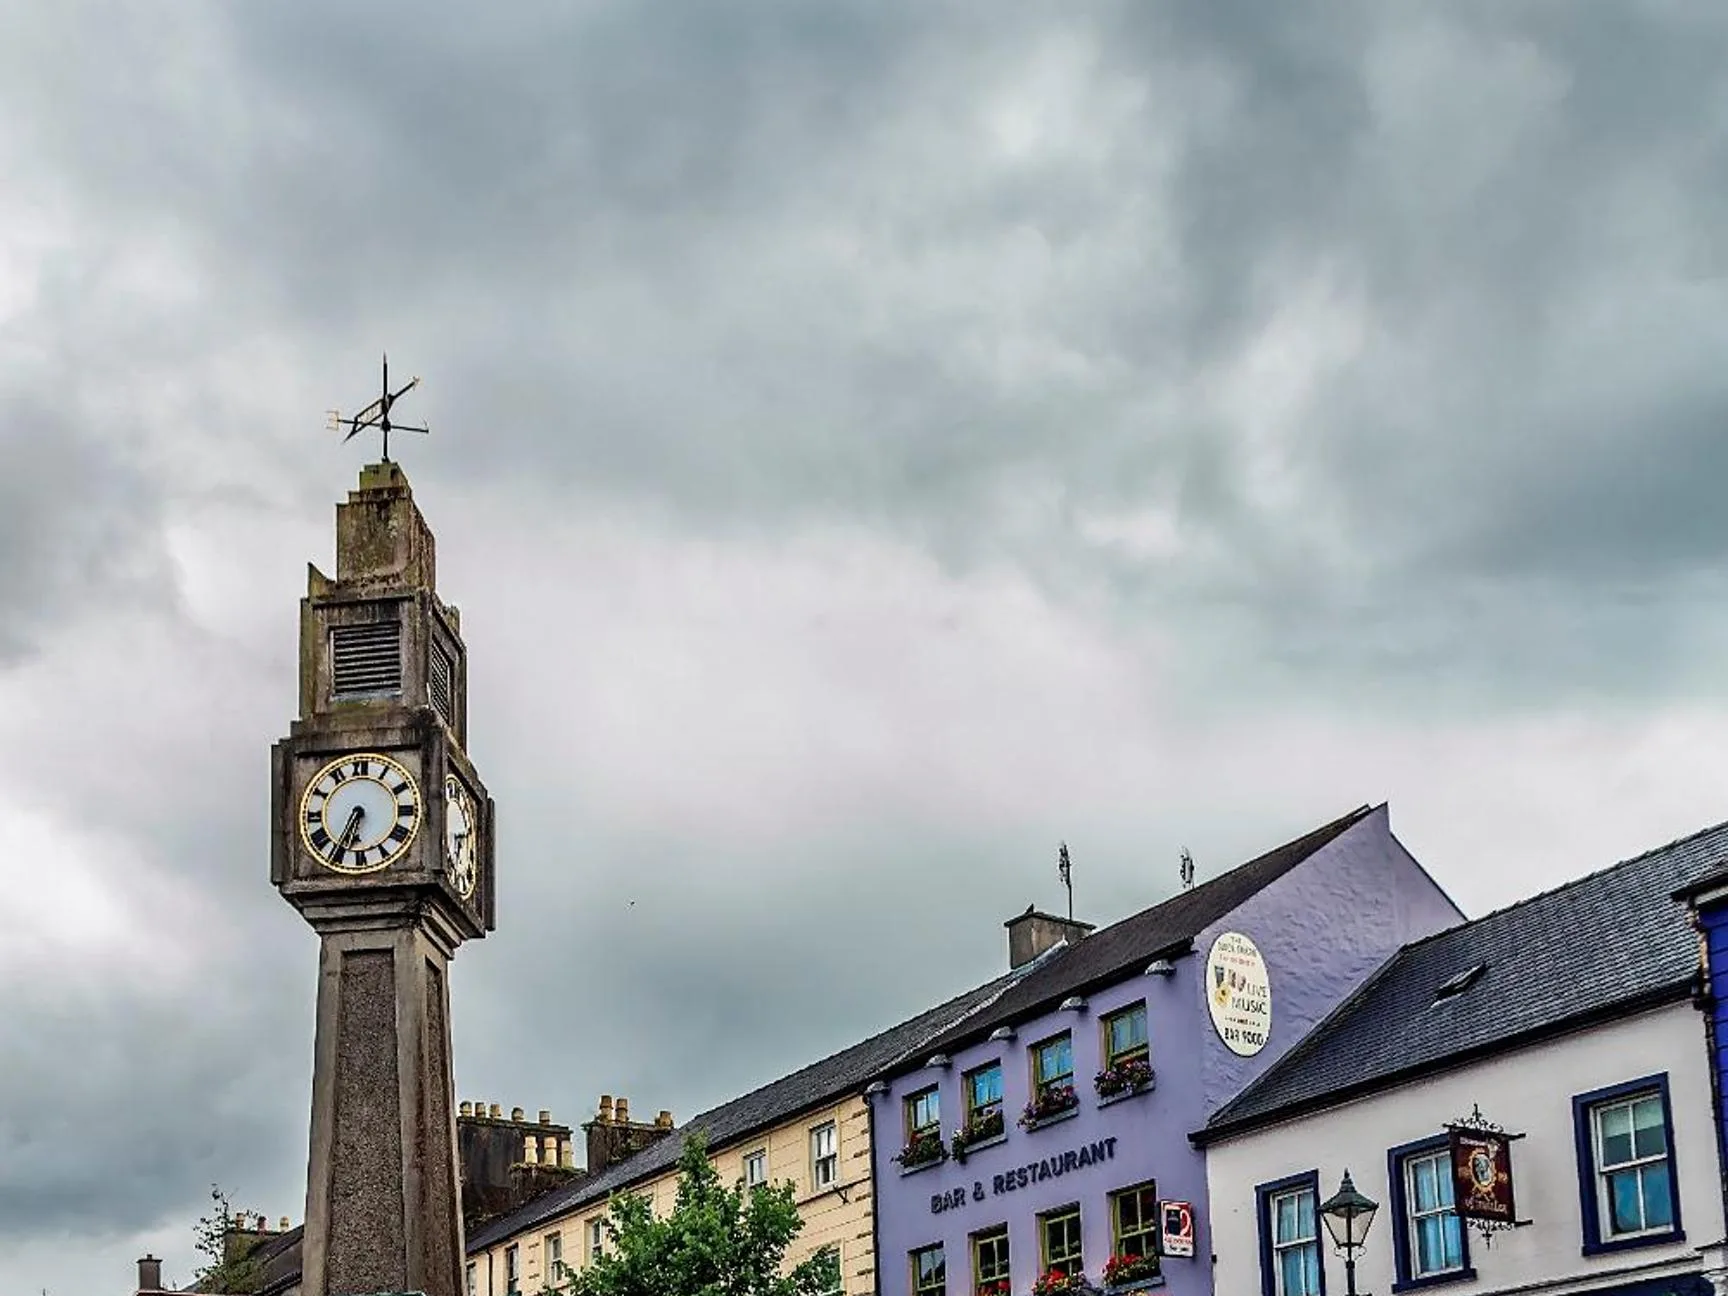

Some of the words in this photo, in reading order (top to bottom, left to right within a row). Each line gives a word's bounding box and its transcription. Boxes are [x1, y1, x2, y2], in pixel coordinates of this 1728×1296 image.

[1231, 996, 1268, 1015] MUSIC
[930, 1187, 966, 1214] BAR
[973, 1181, 986, 1202] &
[992, 1136, 1118, 1196] RESTAURANT
